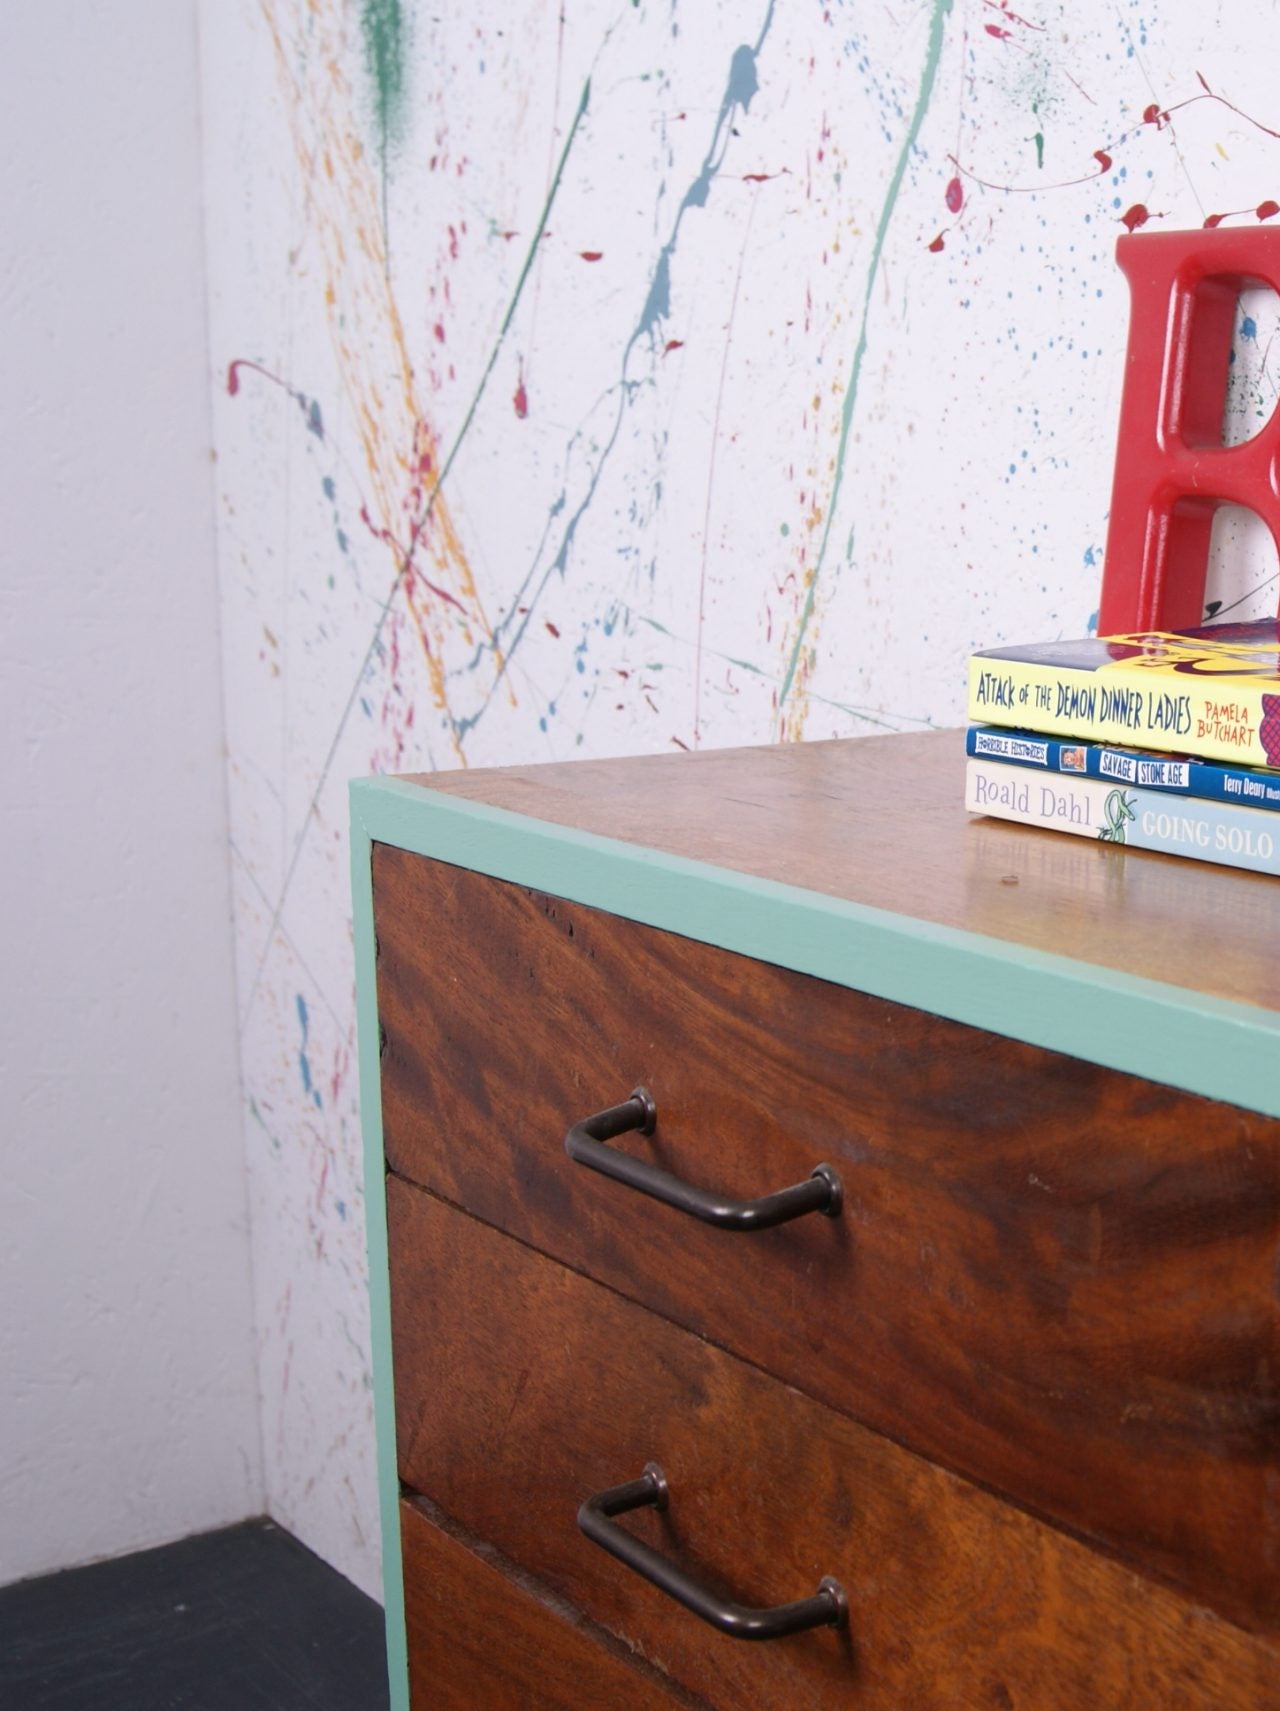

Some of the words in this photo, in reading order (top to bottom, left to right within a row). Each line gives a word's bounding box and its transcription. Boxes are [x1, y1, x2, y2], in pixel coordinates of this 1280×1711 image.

[977, 670, 1015, 709] ATTACK
[1035, 685, 1052, 711] THE
[1055, 681, 1096, 726] DEMON
[1100, 686, 1143, 729] DINNER
[1148, 692, 1191, 735] LADIES
[1204, 700, 1248, 724] PAMELA
[977, 736, 1009, 757] HORRIBLE
[1011, 739, 1045, 761] HISTORIES
[1197, 719, 1256, 748] BUTCHART
[1102, 754, 1132, 779] SAVAGE
[1141, 764, 1166, 785] STONE
[1167, 766, 1184, 786] AGE
[974, 774, 1030, 814] Roald
[1040, 787, 1092, 826] Dahl
[1223, 774, 1243, 795] Terry
[1243, 777, 1266, 799] Deary
[1142, 810, 1211, 847] GOING
[1214, 823, 1274, 860] SOLO
